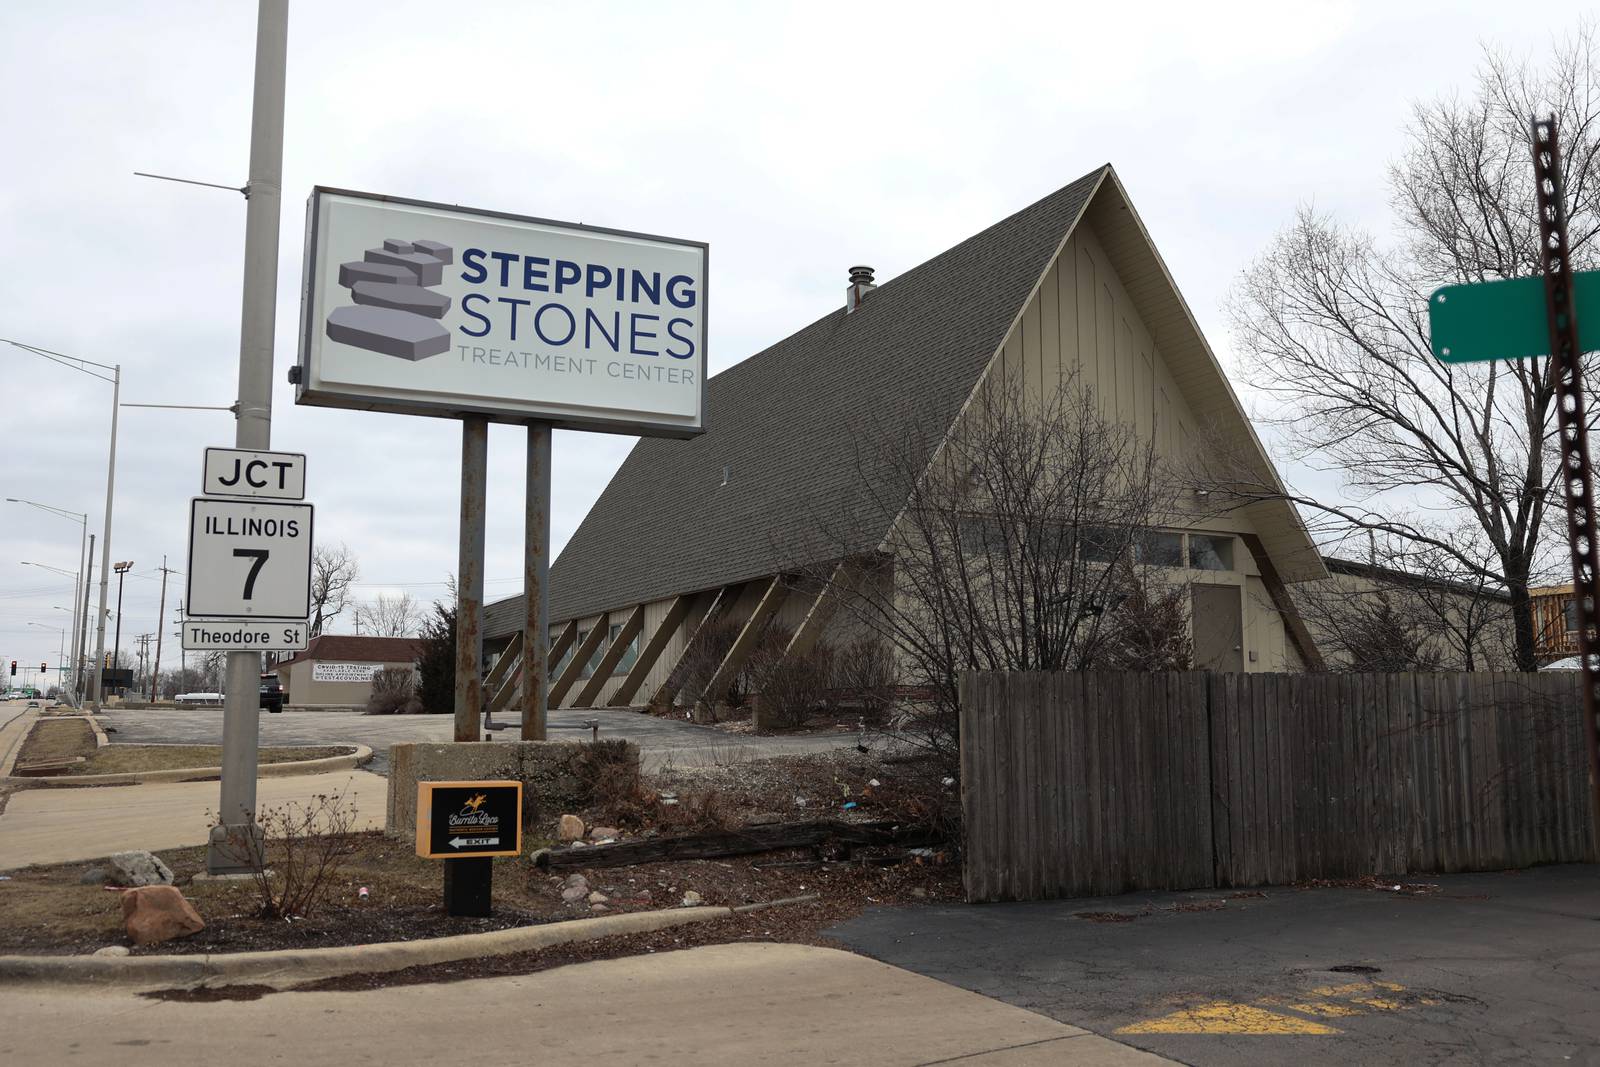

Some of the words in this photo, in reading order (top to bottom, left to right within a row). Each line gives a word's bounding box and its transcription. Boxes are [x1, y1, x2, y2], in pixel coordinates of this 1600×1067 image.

[460, 248, 696, 308] STEPPING
[459, 293, 695, 360] STONES
[457, 345, 597, 375] TREATMENT
[607, 361, 694, 385] CENTER
[218, 458, 293, 489] JCT
[205, 516, 299, 538] ILLINOIS
[232, 548, 269, 600] 7
[191, 628, 270, 643] Theodore
[283, 629, 300, 643] St
[449, 814, 478, 825] Burrito
[479, 813, 499, 826] Loco
